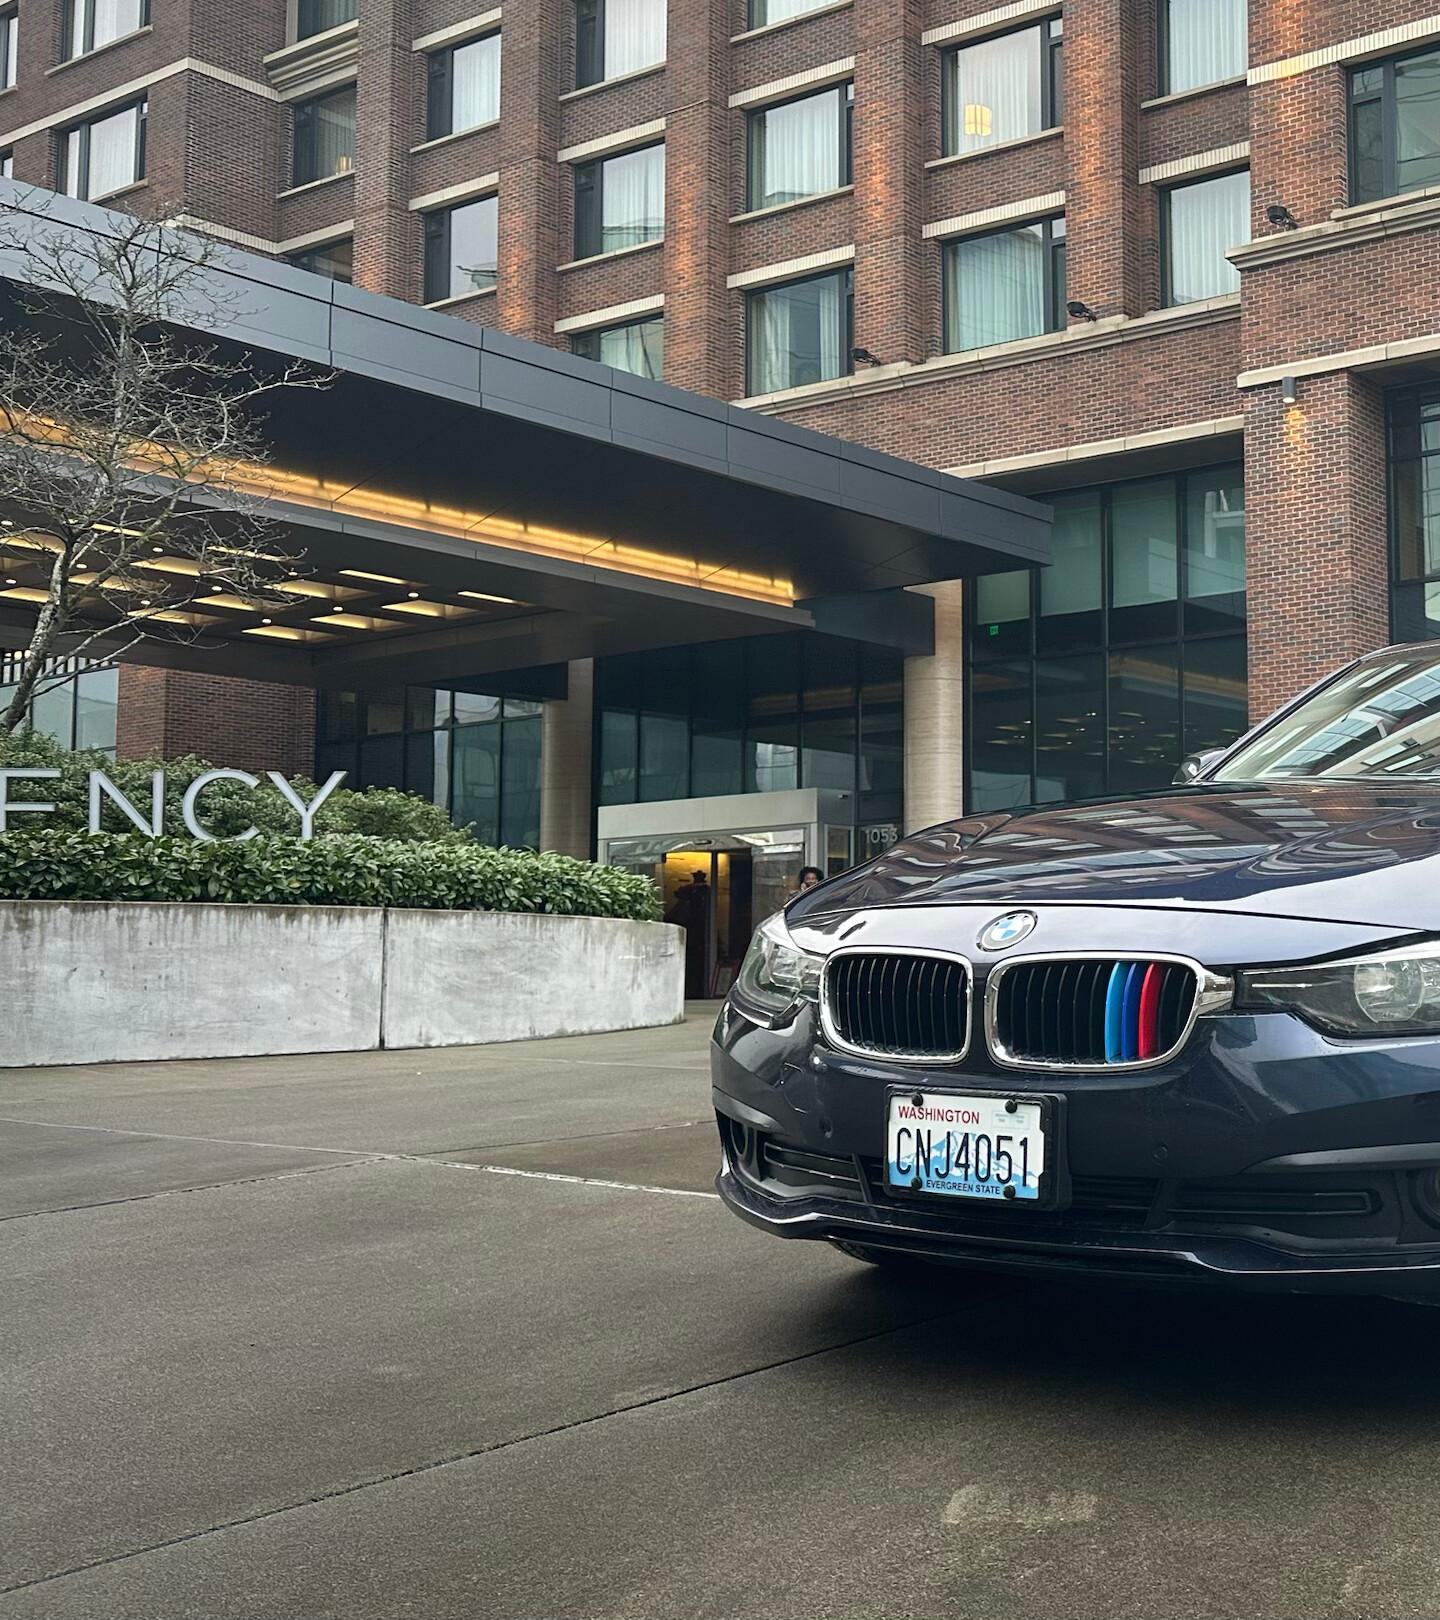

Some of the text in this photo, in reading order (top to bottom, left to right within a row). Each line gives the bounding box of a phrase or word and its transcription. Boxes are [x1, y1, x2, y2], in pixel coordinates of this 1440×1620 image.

[898, 1105, 980, 1125] WASHINGTON
[896, 1127, 1028, 1187] CNJ4051
[926, 1179, 1001, 1195] EVERGREEN STATE
